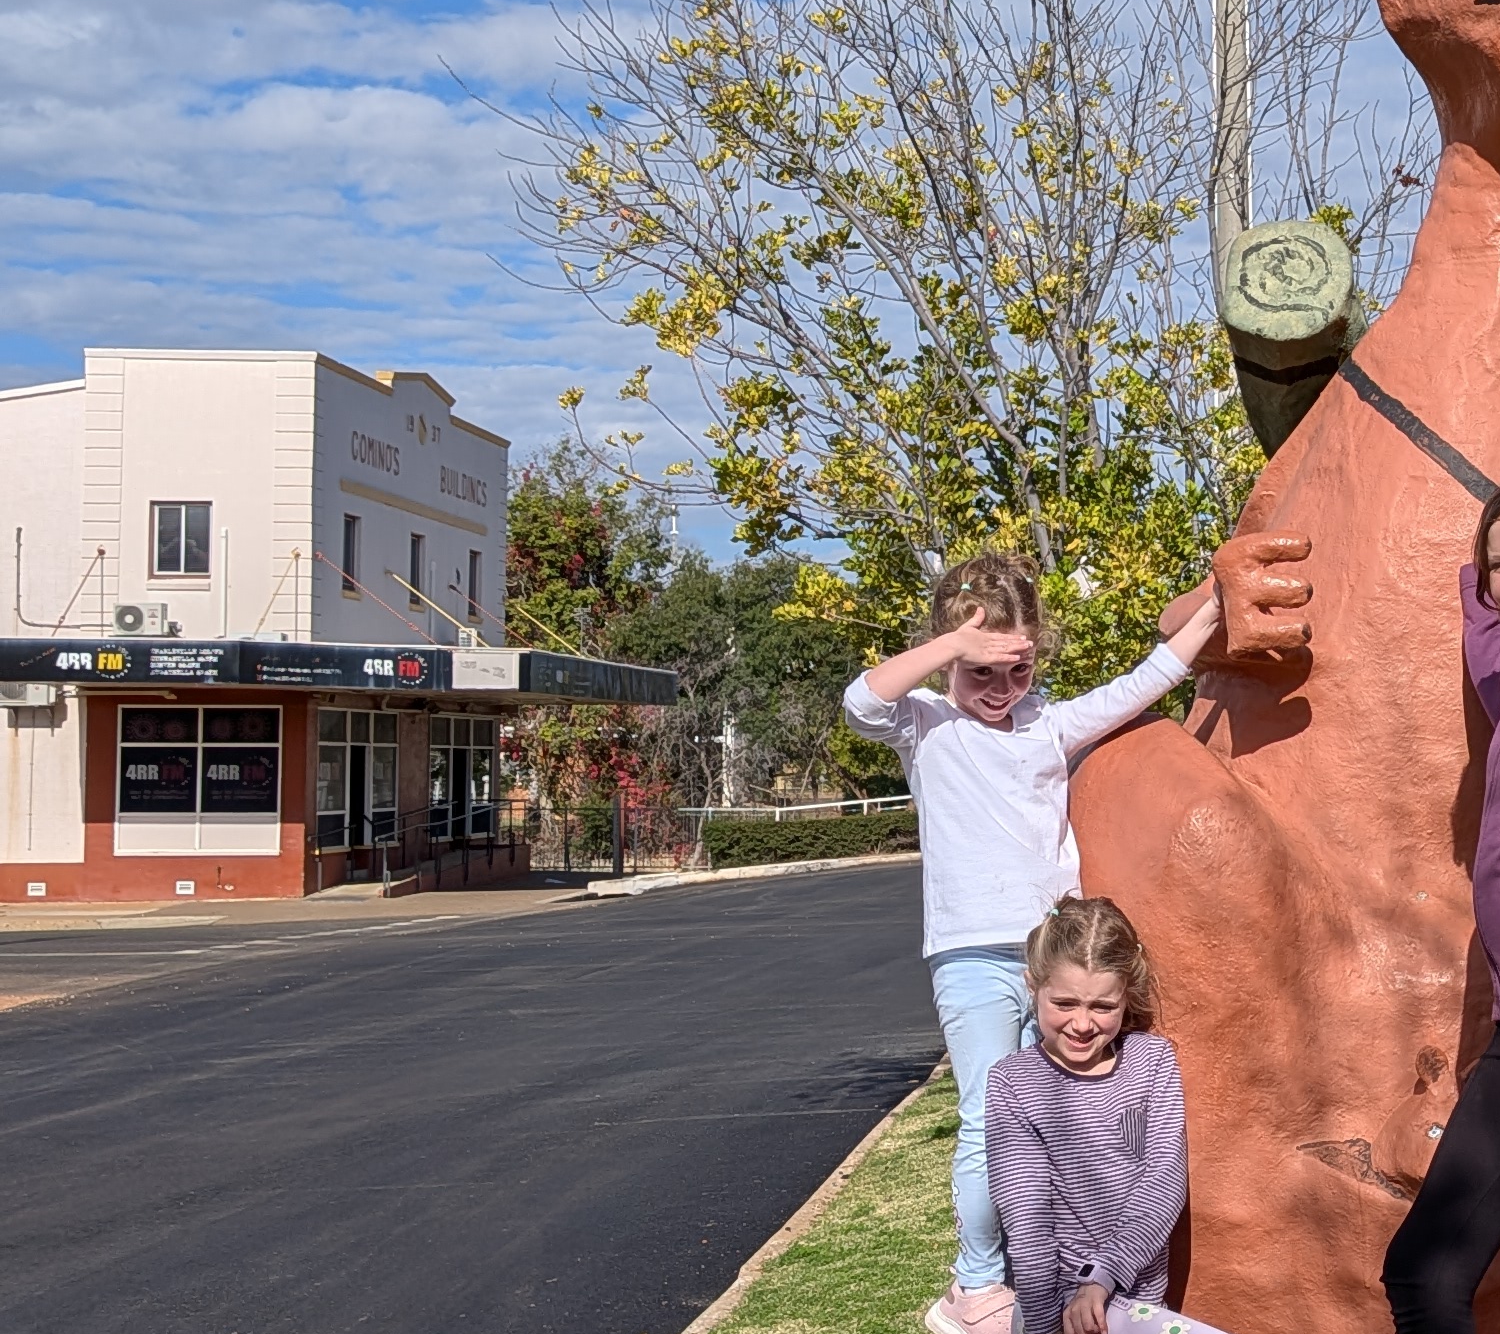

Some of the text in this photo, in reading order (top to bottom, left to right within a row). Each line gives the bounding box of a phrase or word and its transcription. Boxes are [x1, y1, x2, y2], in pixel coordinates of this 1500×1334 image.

[55, 652, 93, 670] 4RR
[97, 653, 123, 670] FM
[363, 658, 394, 676] 4RR
[398, 660, 420, 677] FM
[125, 764, 159, 780] 4RR
[206, 764, 240, 780] 4RR
